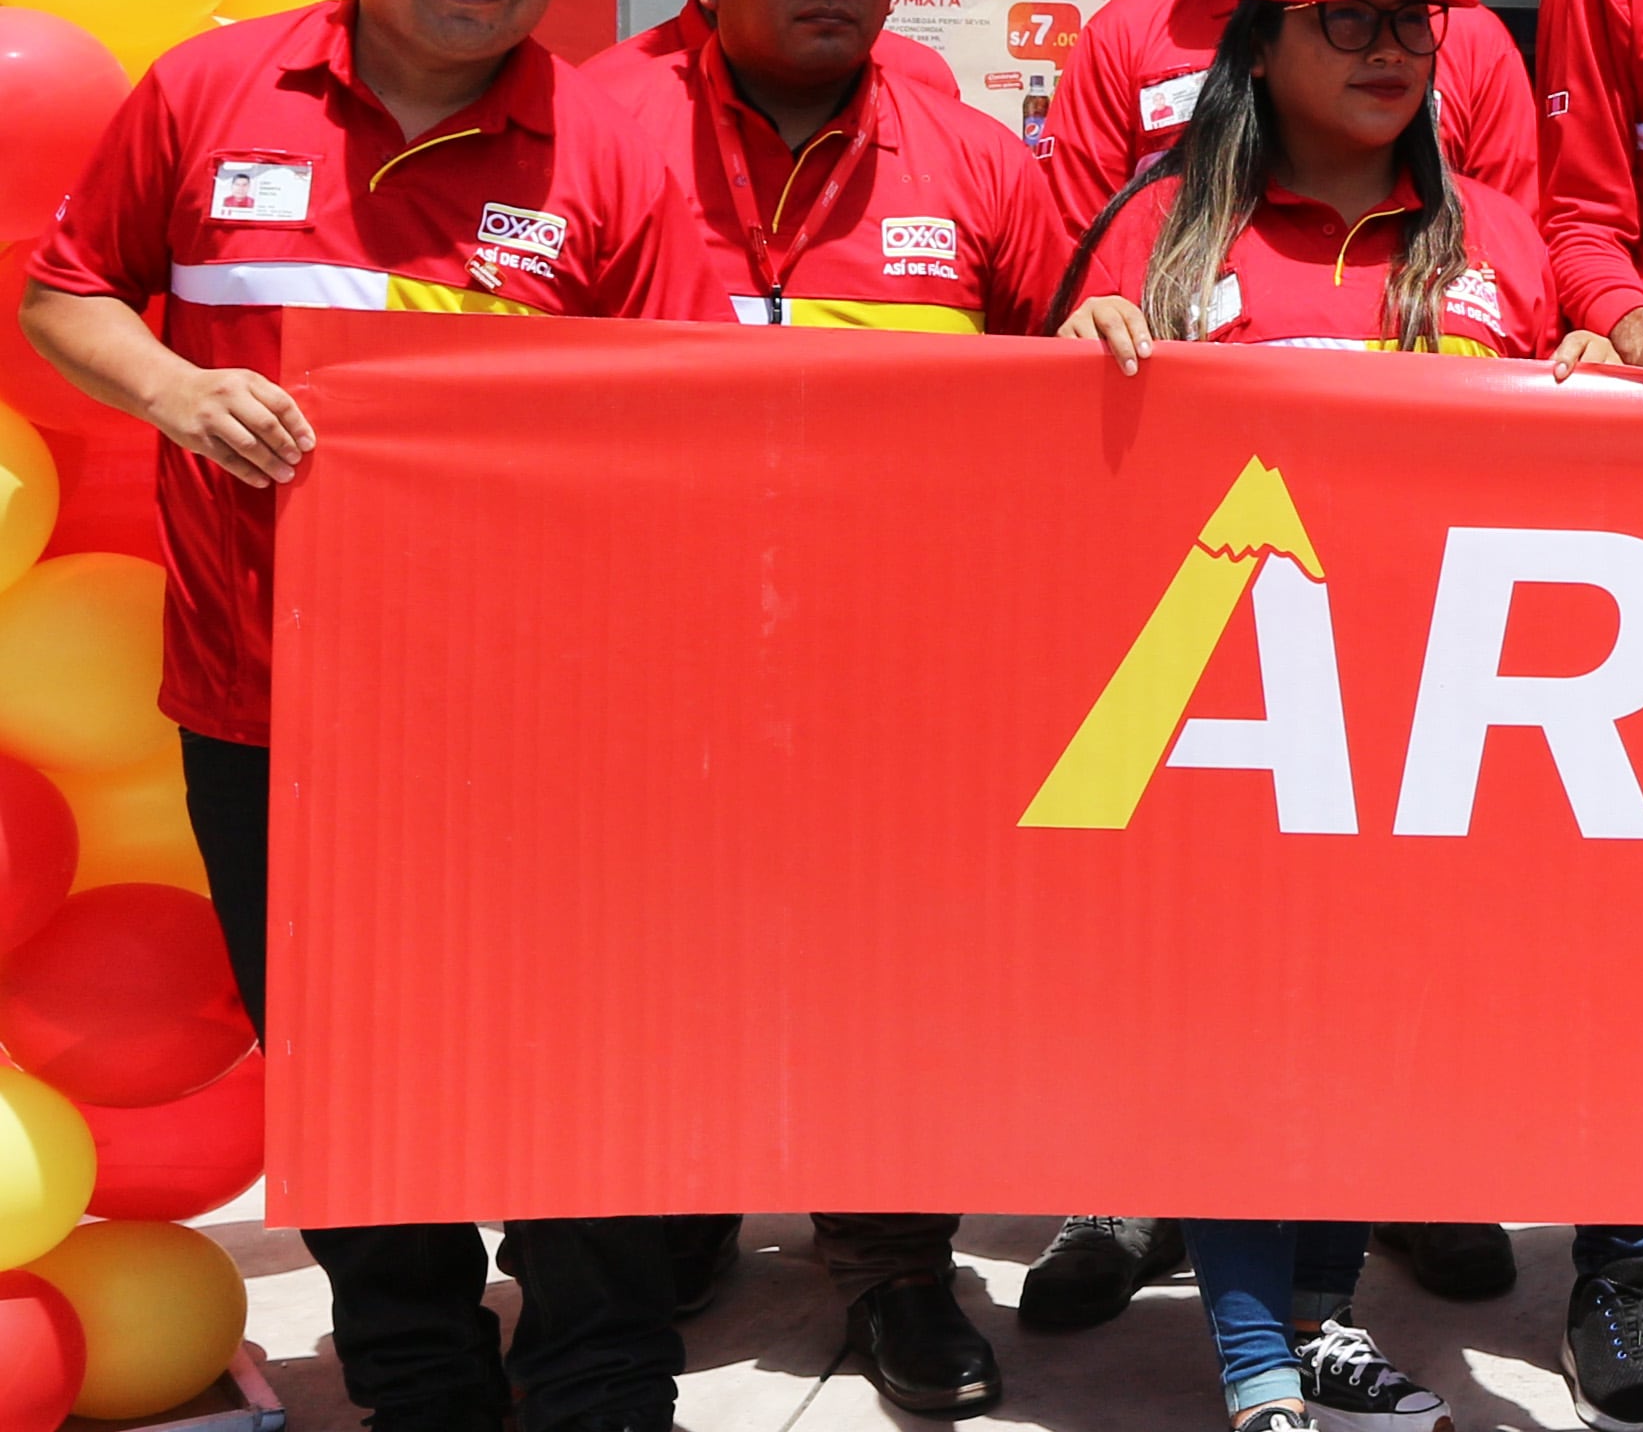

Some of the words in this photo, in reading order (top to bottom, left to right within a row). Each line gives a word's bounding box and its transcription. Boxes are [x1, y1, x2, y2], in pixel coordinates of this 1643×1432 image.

[485, 211, 560, 249] OXXO
[886, 225, 953, 250] OXXO
[476, 245, 498, 264] ASÍ
[500, 252, 519, 269] DE
[521, 254, 555, 279] FÁCIL
[883, 261, 905, 276] ASÍ
[908, 262, 927, 277] DE
[928, 261, 958, 279] FÁCIL
[1447, 301, 1467, 316] ASÍ
